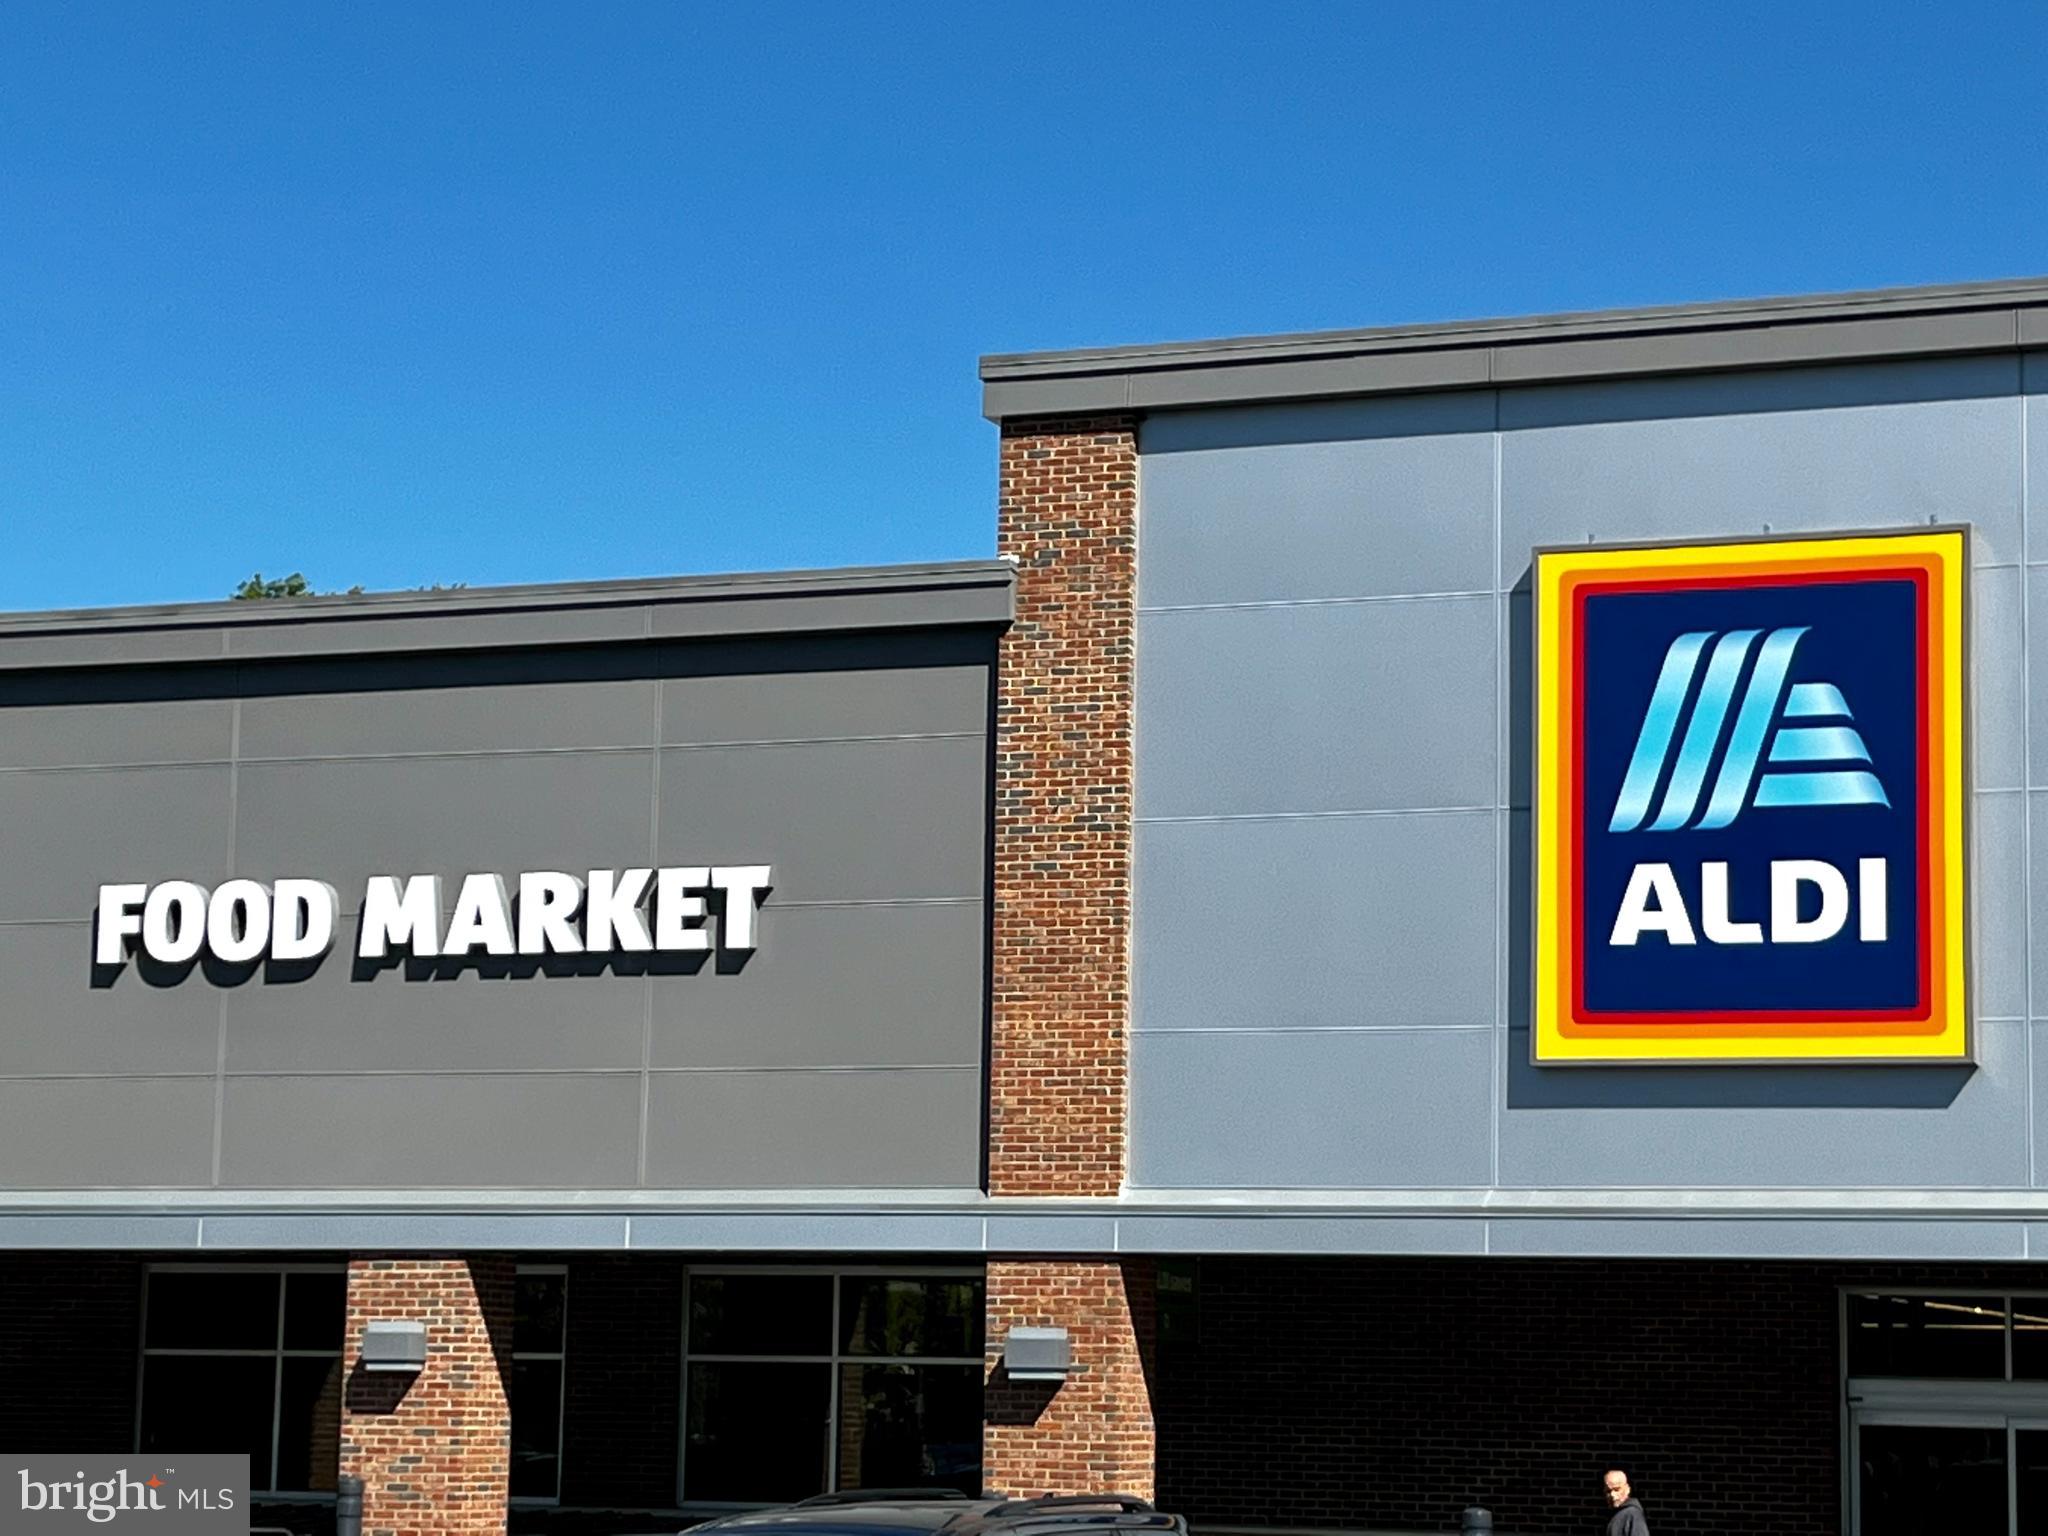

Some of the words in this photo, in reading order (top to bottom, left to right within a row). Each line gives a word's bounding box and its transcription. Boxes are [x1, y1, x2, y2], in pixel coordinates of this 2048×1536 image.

[96, 879, 335, 963] FOOD
[358, 865, 772, 957] MARKET
[1609, 857, 1888, 946] ALDI
